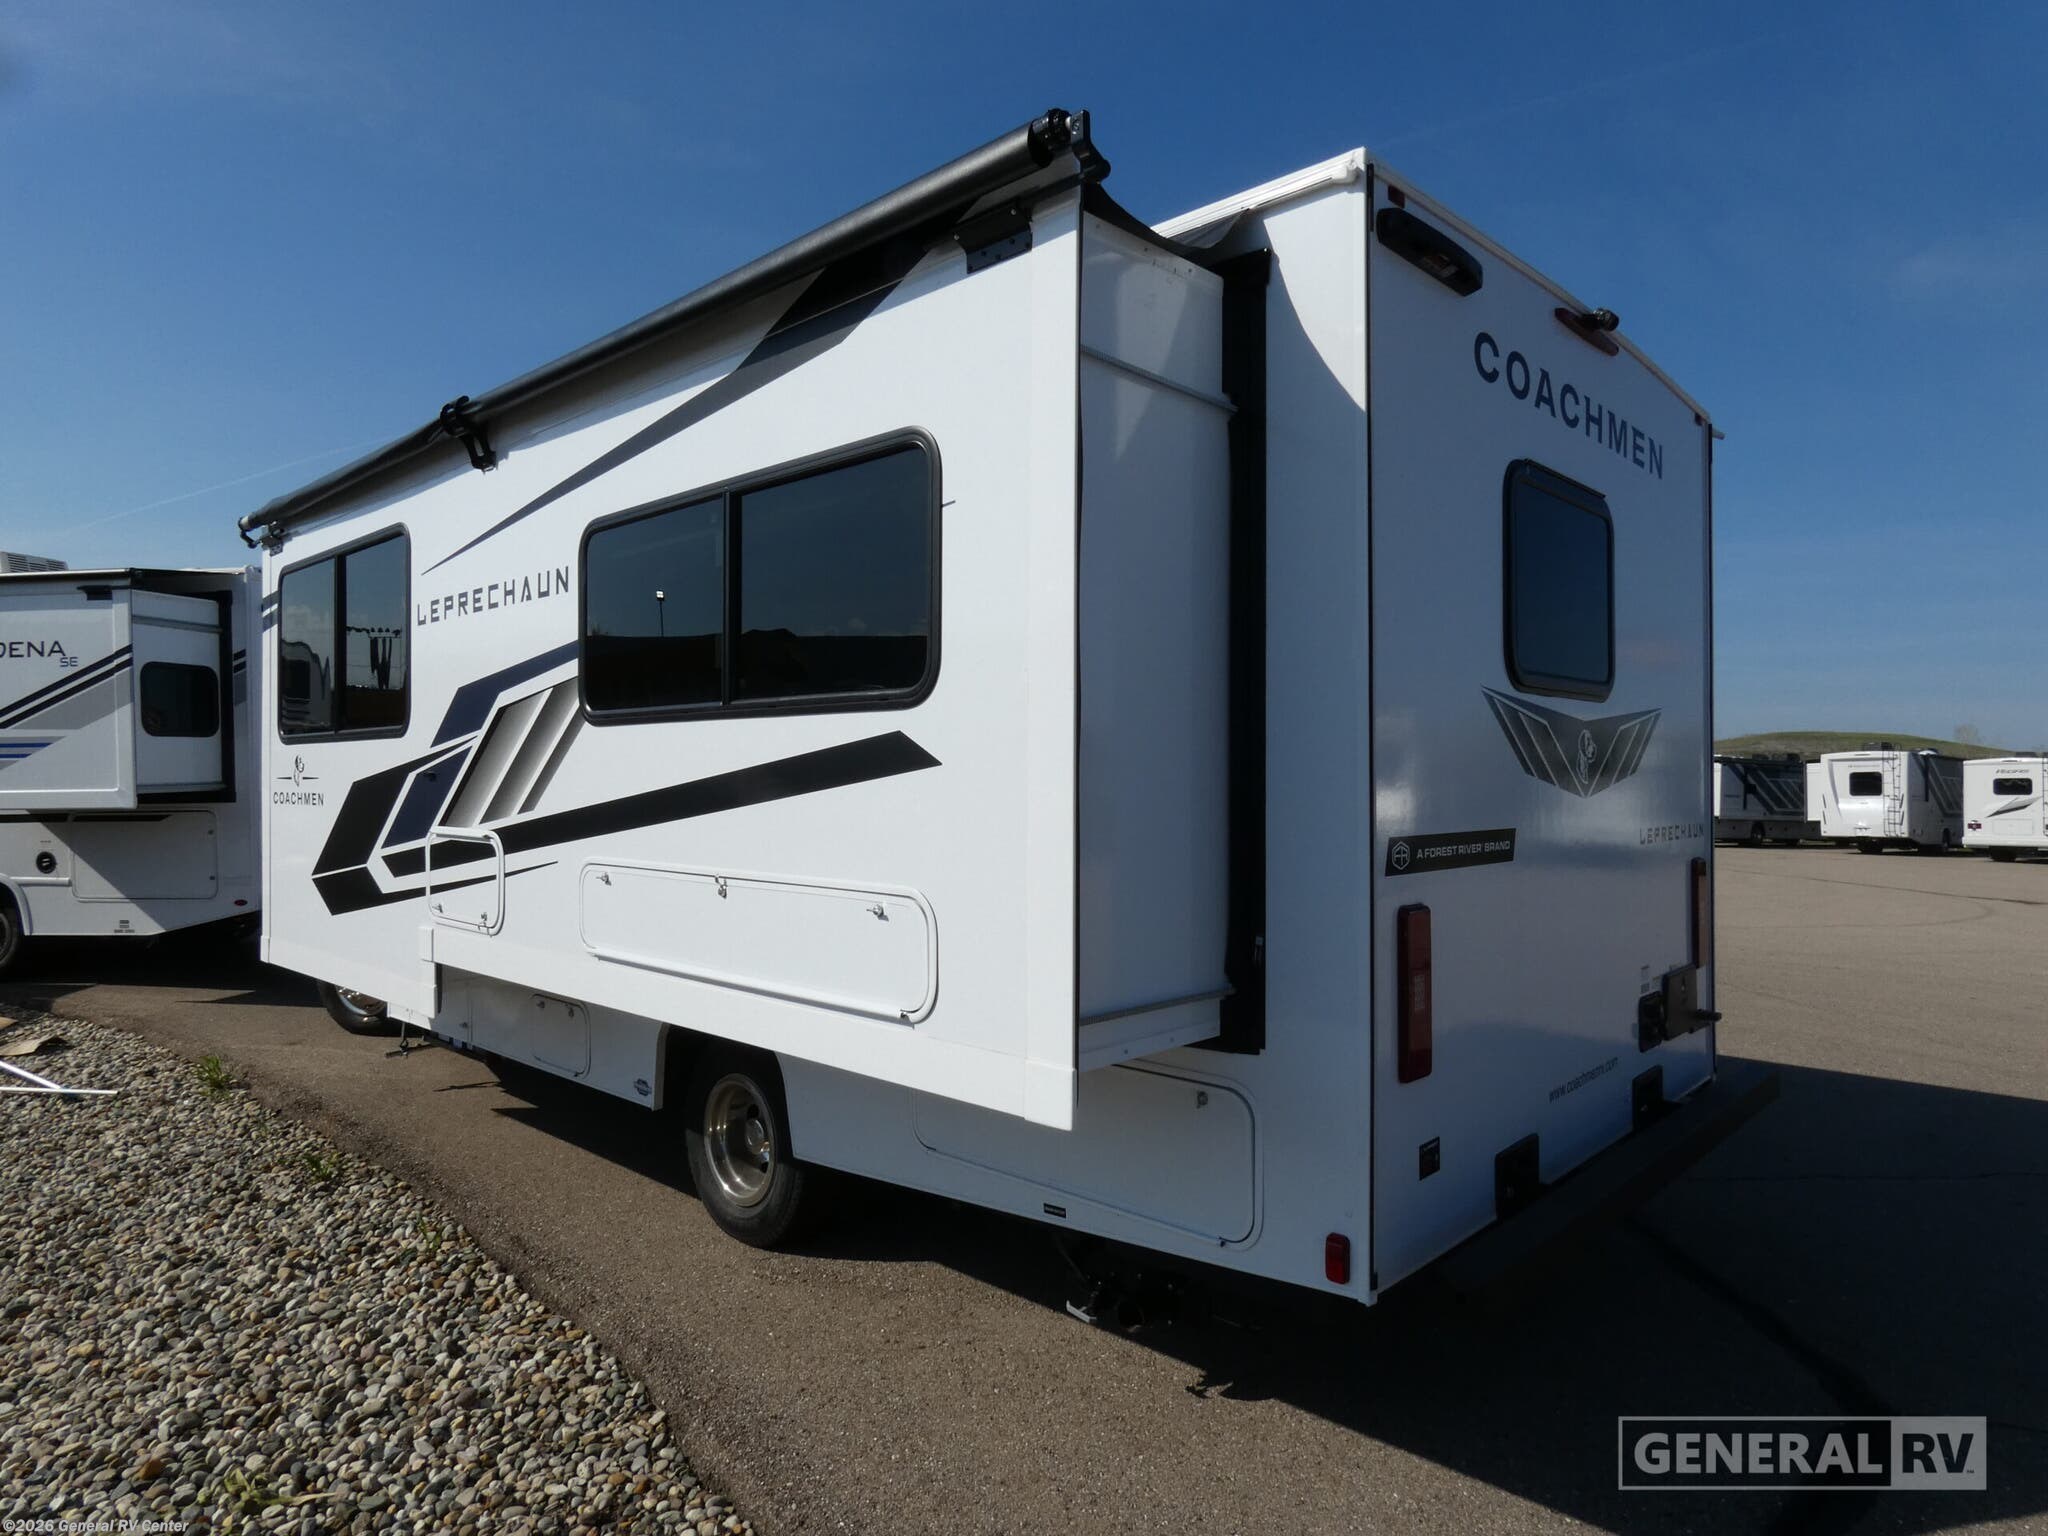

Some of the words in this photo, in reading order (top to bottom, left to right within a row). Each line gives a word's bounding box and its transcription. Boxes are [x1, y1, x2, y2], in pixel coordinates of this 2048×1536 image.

[1474, 332, 1663, 480] COACHMEN
[417, 565, 569, 627] LEPRECHAUN
[60, 656, 79, 667] SE
[272, 791, 325, 806] COACHMEN
[1640, 823, 1705, 845] LEPRECHAUN
[1416, 849, 1424, 859] A
[1424, 845, 1458, 859] FOREST
[1458, 843, 1482, 855] RIVER
[1484, 840, 1511, 853] BRAND
